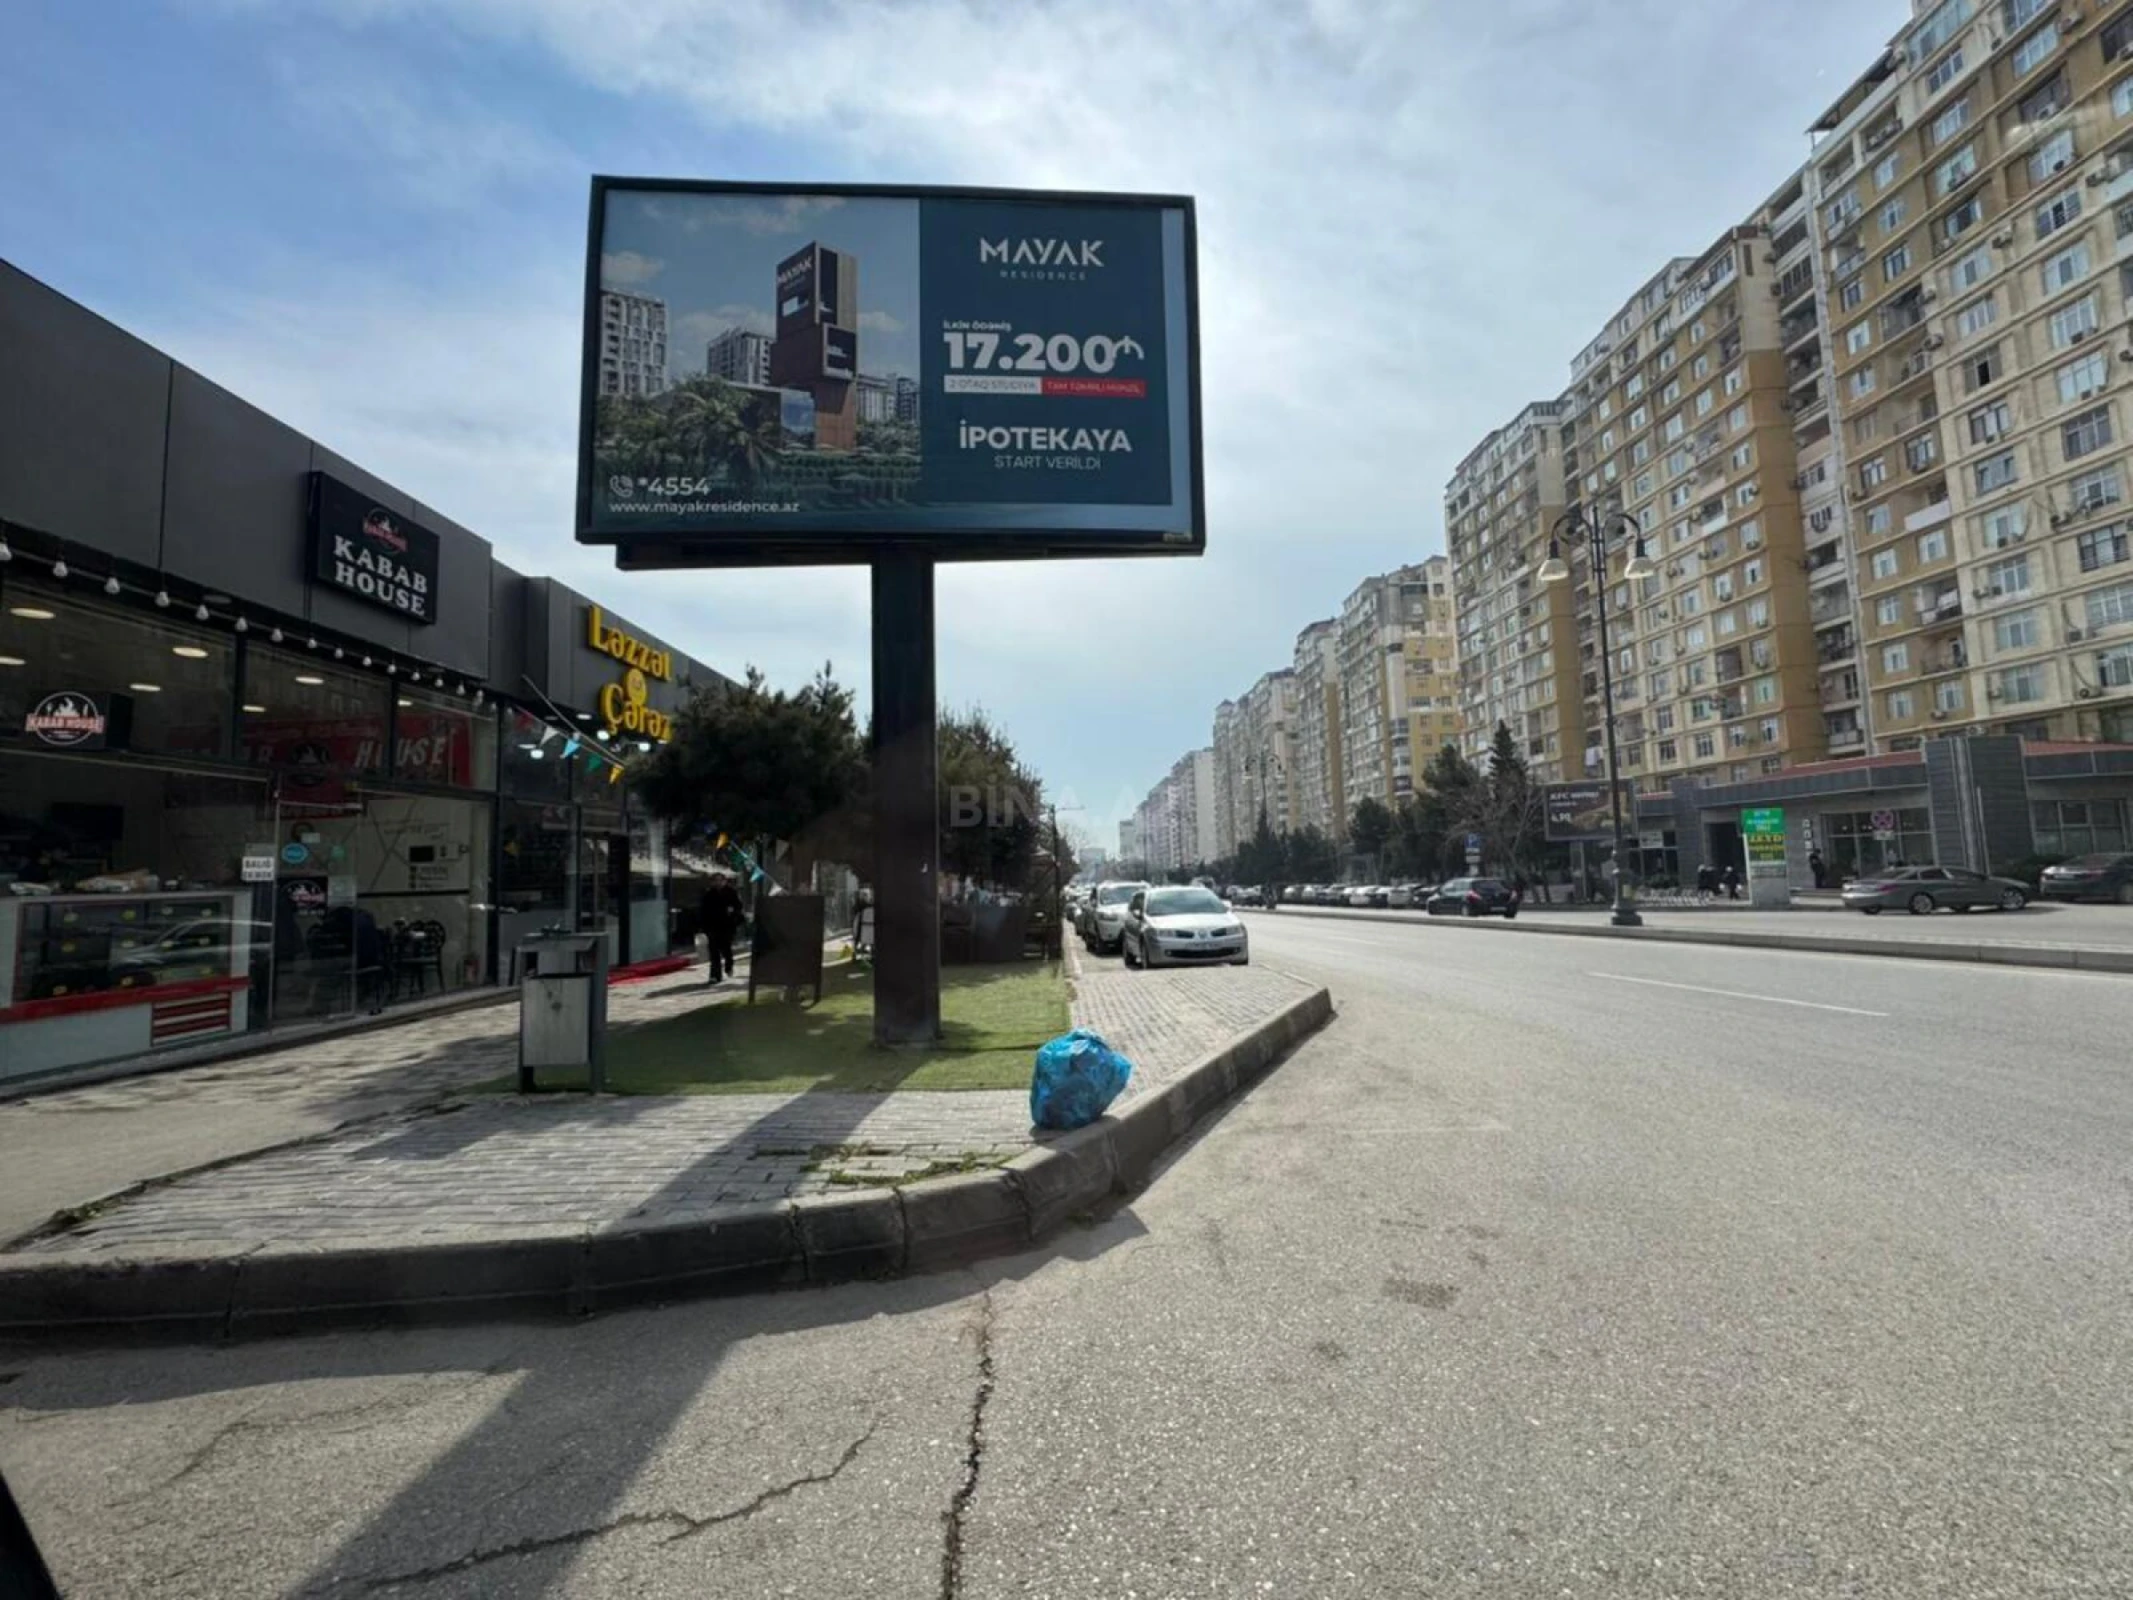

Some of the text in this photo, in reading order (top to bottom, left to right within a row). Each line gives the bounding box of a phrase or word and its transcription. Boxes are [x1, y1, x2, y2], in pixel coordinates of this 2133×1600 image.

[980, 238, 1104, 267] MAYAK
[959, 418, 1132, 452] İPOTEKAYA
[994, 456, 1042, 469] START
[609, 500, 800, 516] www.mayakresidence.az
[333, 534, 427, 593] KABAB
[335, 560, 425, 617] HOUSE
